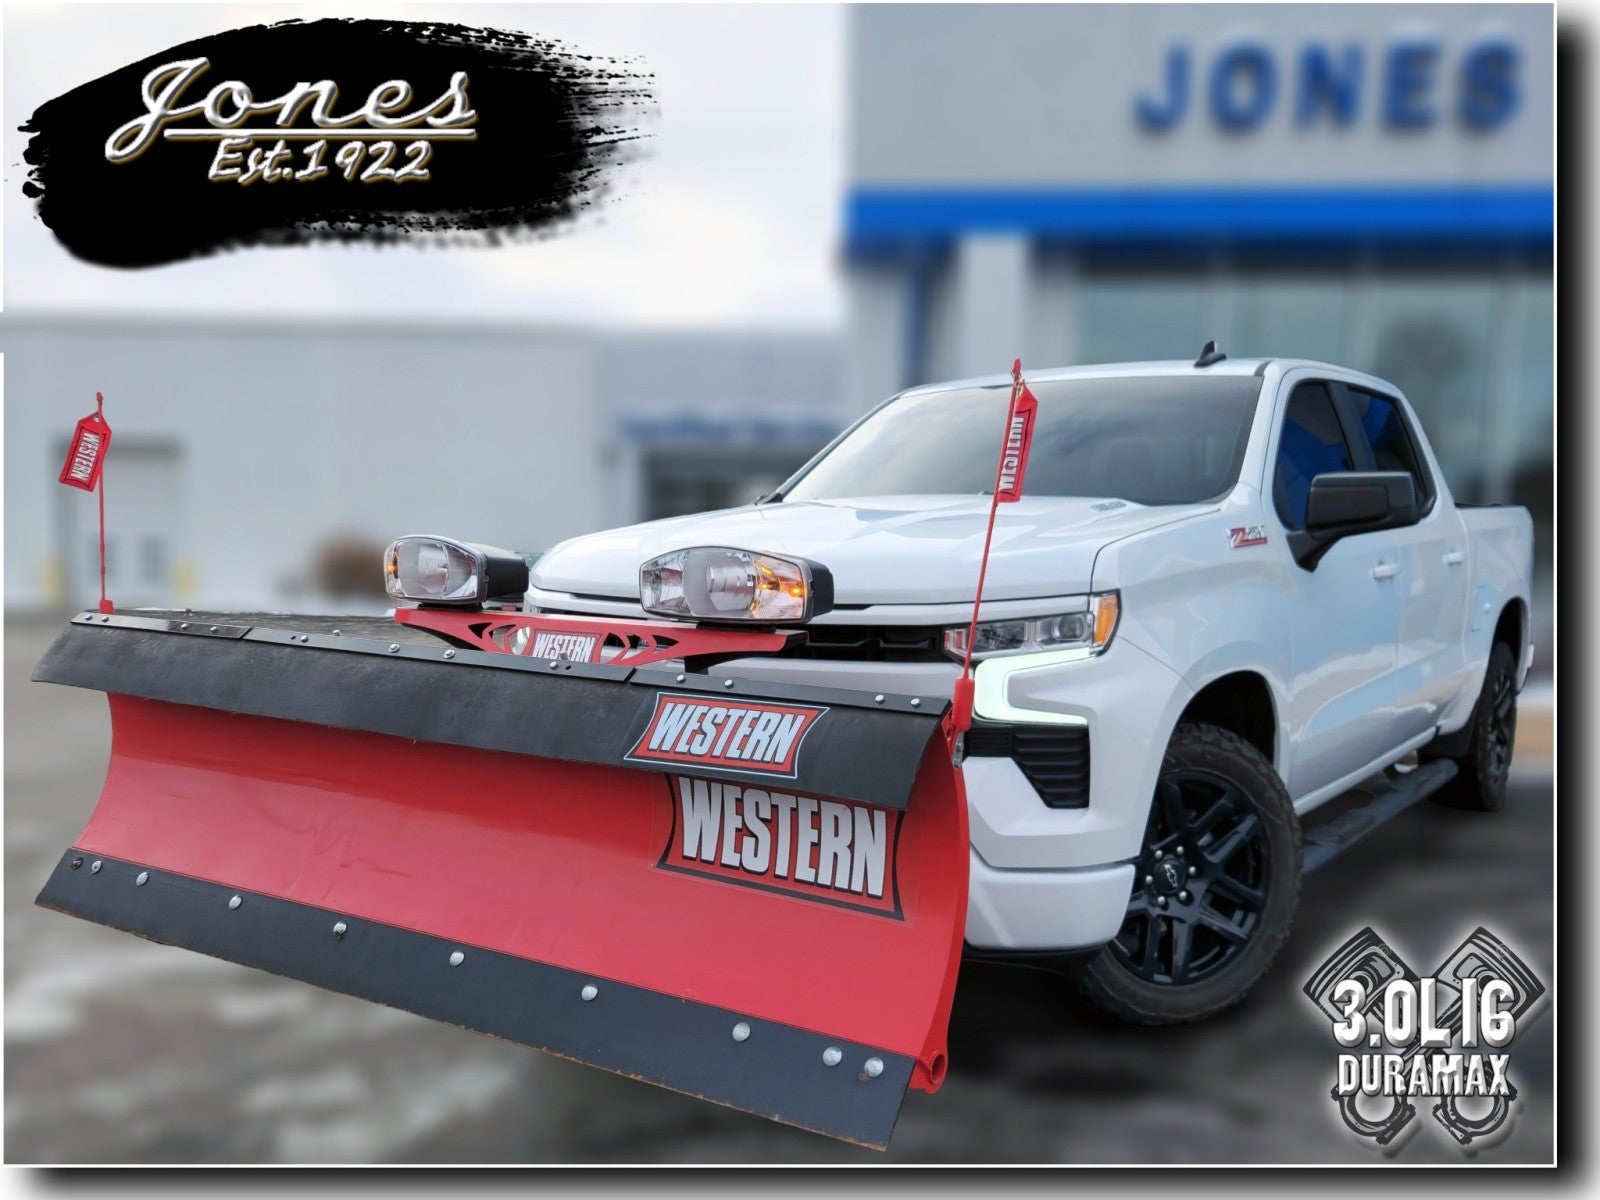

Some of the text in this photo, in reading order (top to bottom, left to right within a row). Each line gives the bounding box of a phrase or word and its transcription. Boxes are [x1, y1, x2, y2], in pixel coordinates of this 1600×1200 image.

[1134, 42, 1522, 134] JONES
[70, 432, 100, 481] WESTERN
[532, 634, 596, 662] WESTERN
[648, 702, 805, 764] WESTERN
[678, 776, 886, 899] WESTERN
